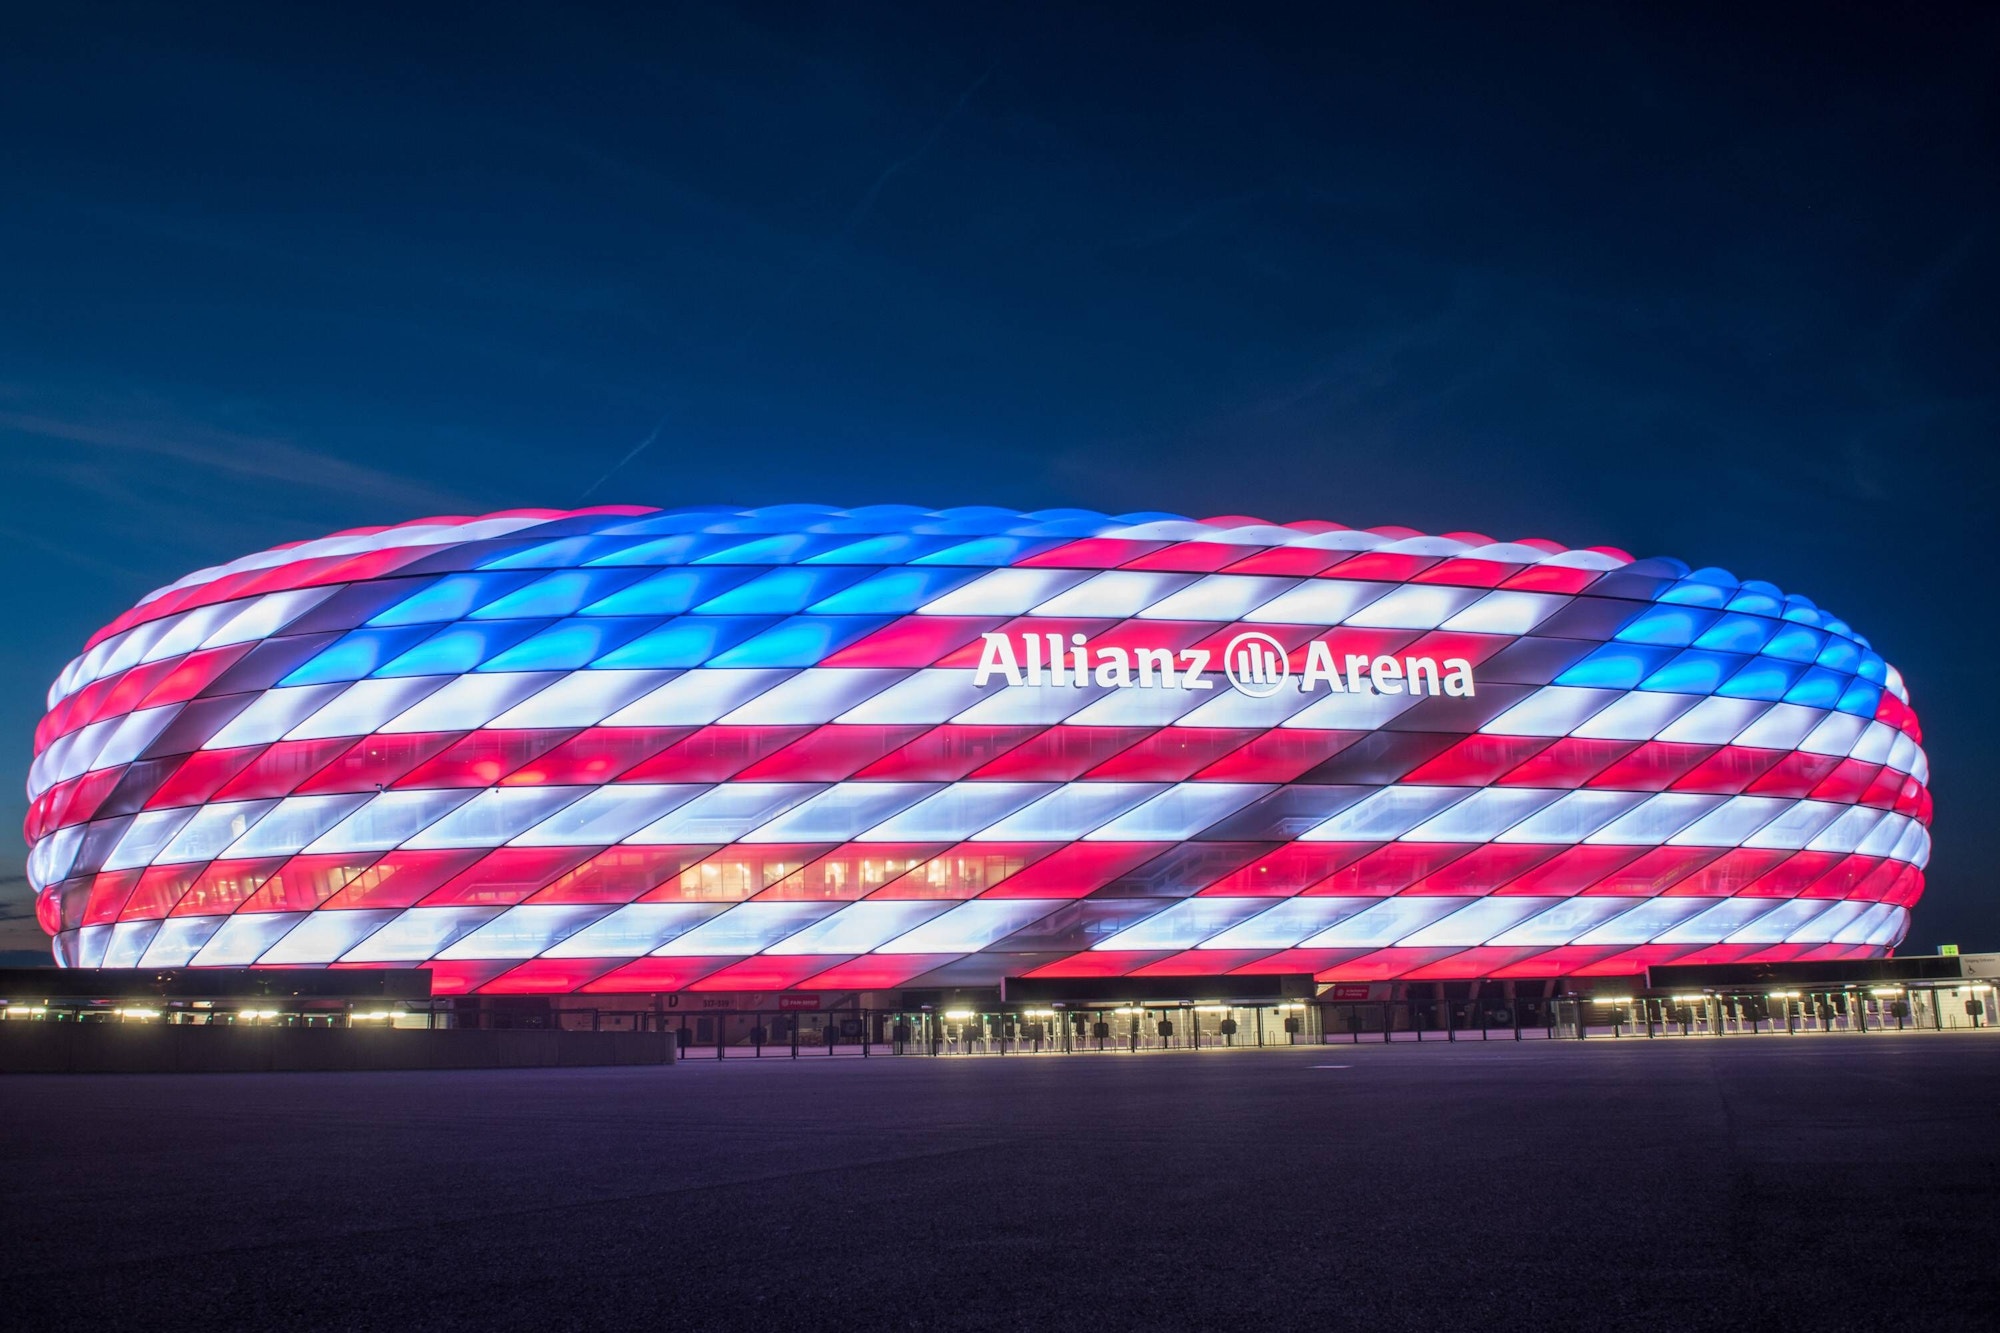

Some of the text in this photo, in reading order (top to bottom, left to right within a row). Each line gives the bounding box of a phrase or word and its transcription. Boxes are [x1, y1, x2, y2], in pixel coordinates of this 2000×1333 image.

[973, 632, 1475, 697] Allianz Arena
[668, 994, 679, 1008] D
